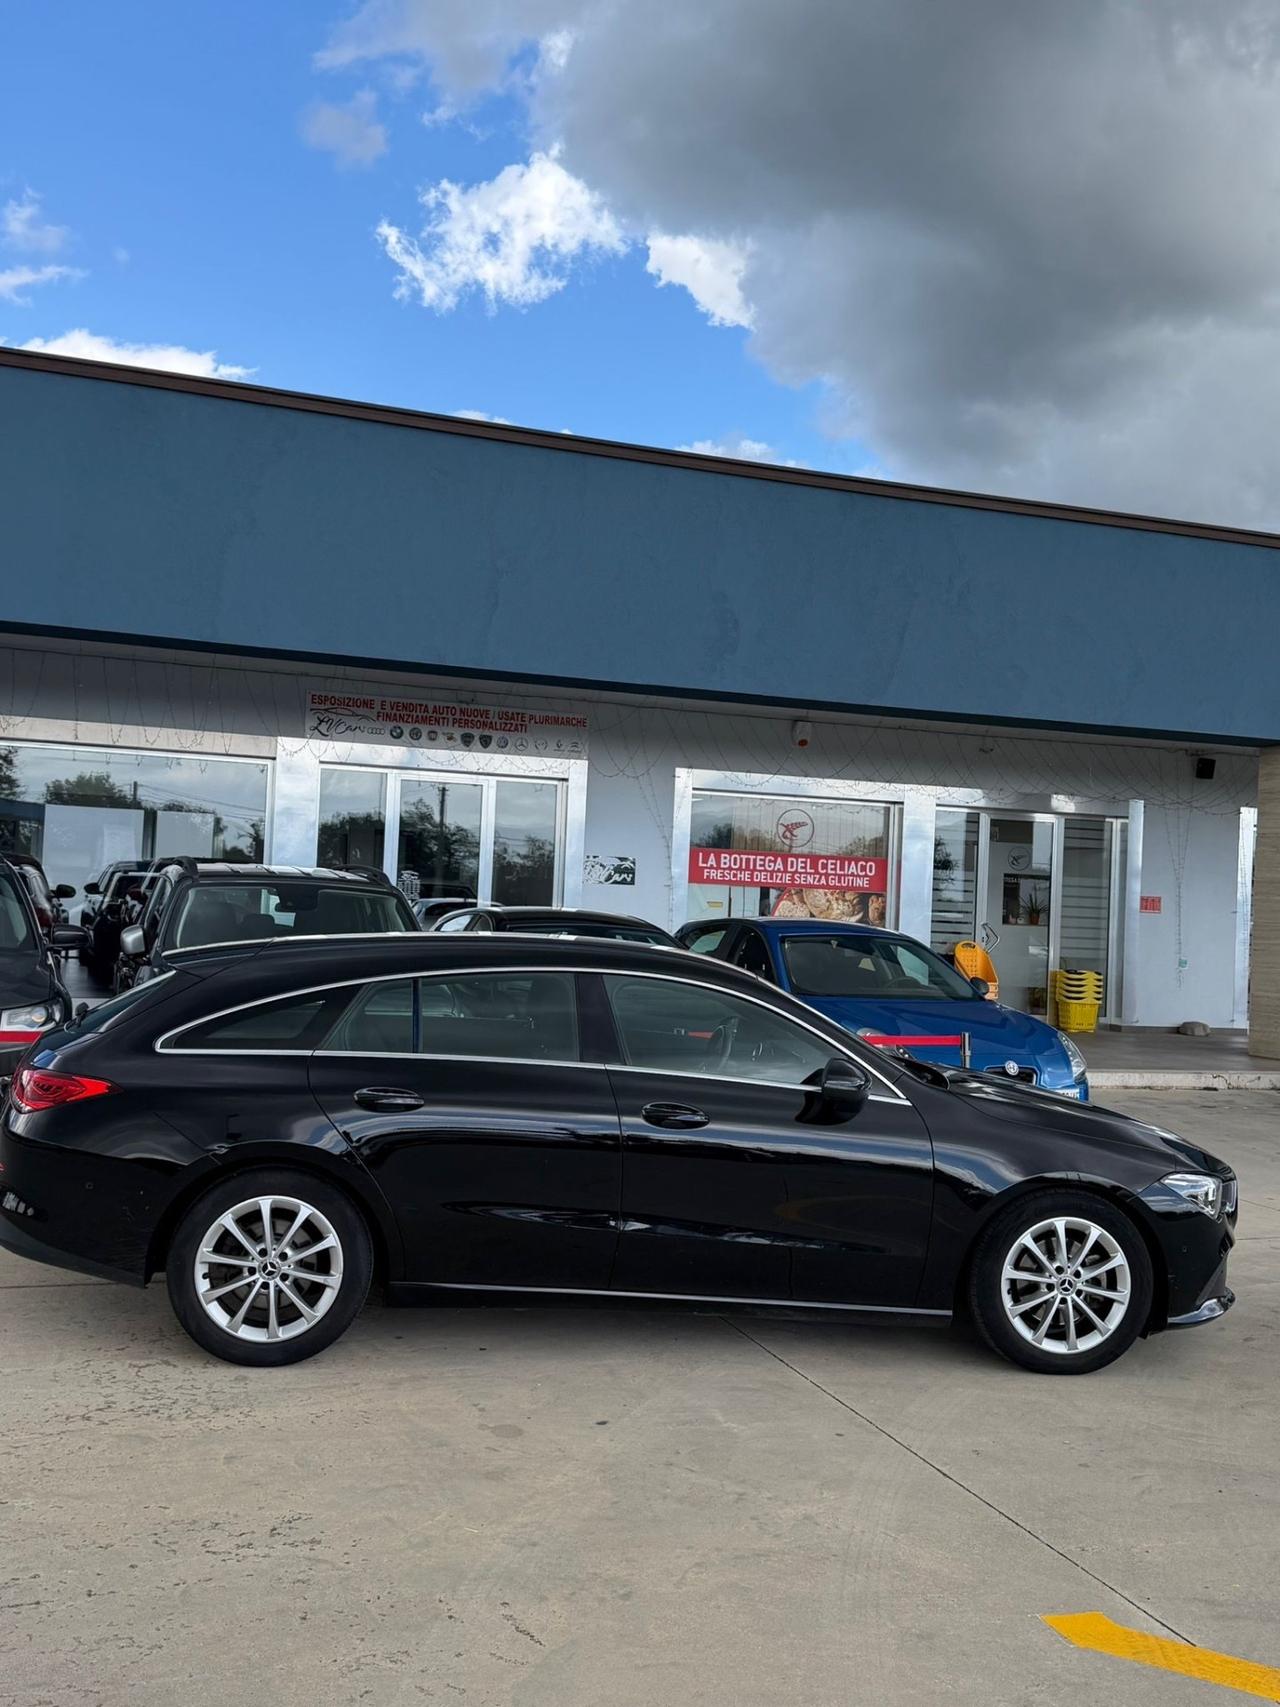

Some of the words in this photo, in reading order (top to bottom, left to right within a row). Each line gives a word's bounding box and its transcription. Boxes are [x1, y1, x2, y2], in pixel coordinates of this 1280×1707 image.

[311, 694, 375, 710] ESPOSIZIONE
[380, 700, 387, 710] E
[390, 701, 429, 714] VENDITA
[432, 705, 457, 716] AUTO
[460, 707, 491, 719] NUOVE
[498, 711, 526, 723] USATE
[528, 714, 587, 728] PLURIMARCHE
[376, 712, 450, 727] FINANZIAMENTI
[452, 718, 528, 733] PERSONALIZZATI
[698, 852, 715, 868] LA
[720, 853, 784, 872] BOTTEGA
[787, 856, 814, 873] DEL
[818, 859, 876, 876] CELIACO
[703, 869, 751, 882] FRESCHE
[754, 871, 791, 884] DELIZIE
[794, 873, 827, 886] SENZA
[828, 875, 869, 888] GLUTINE
